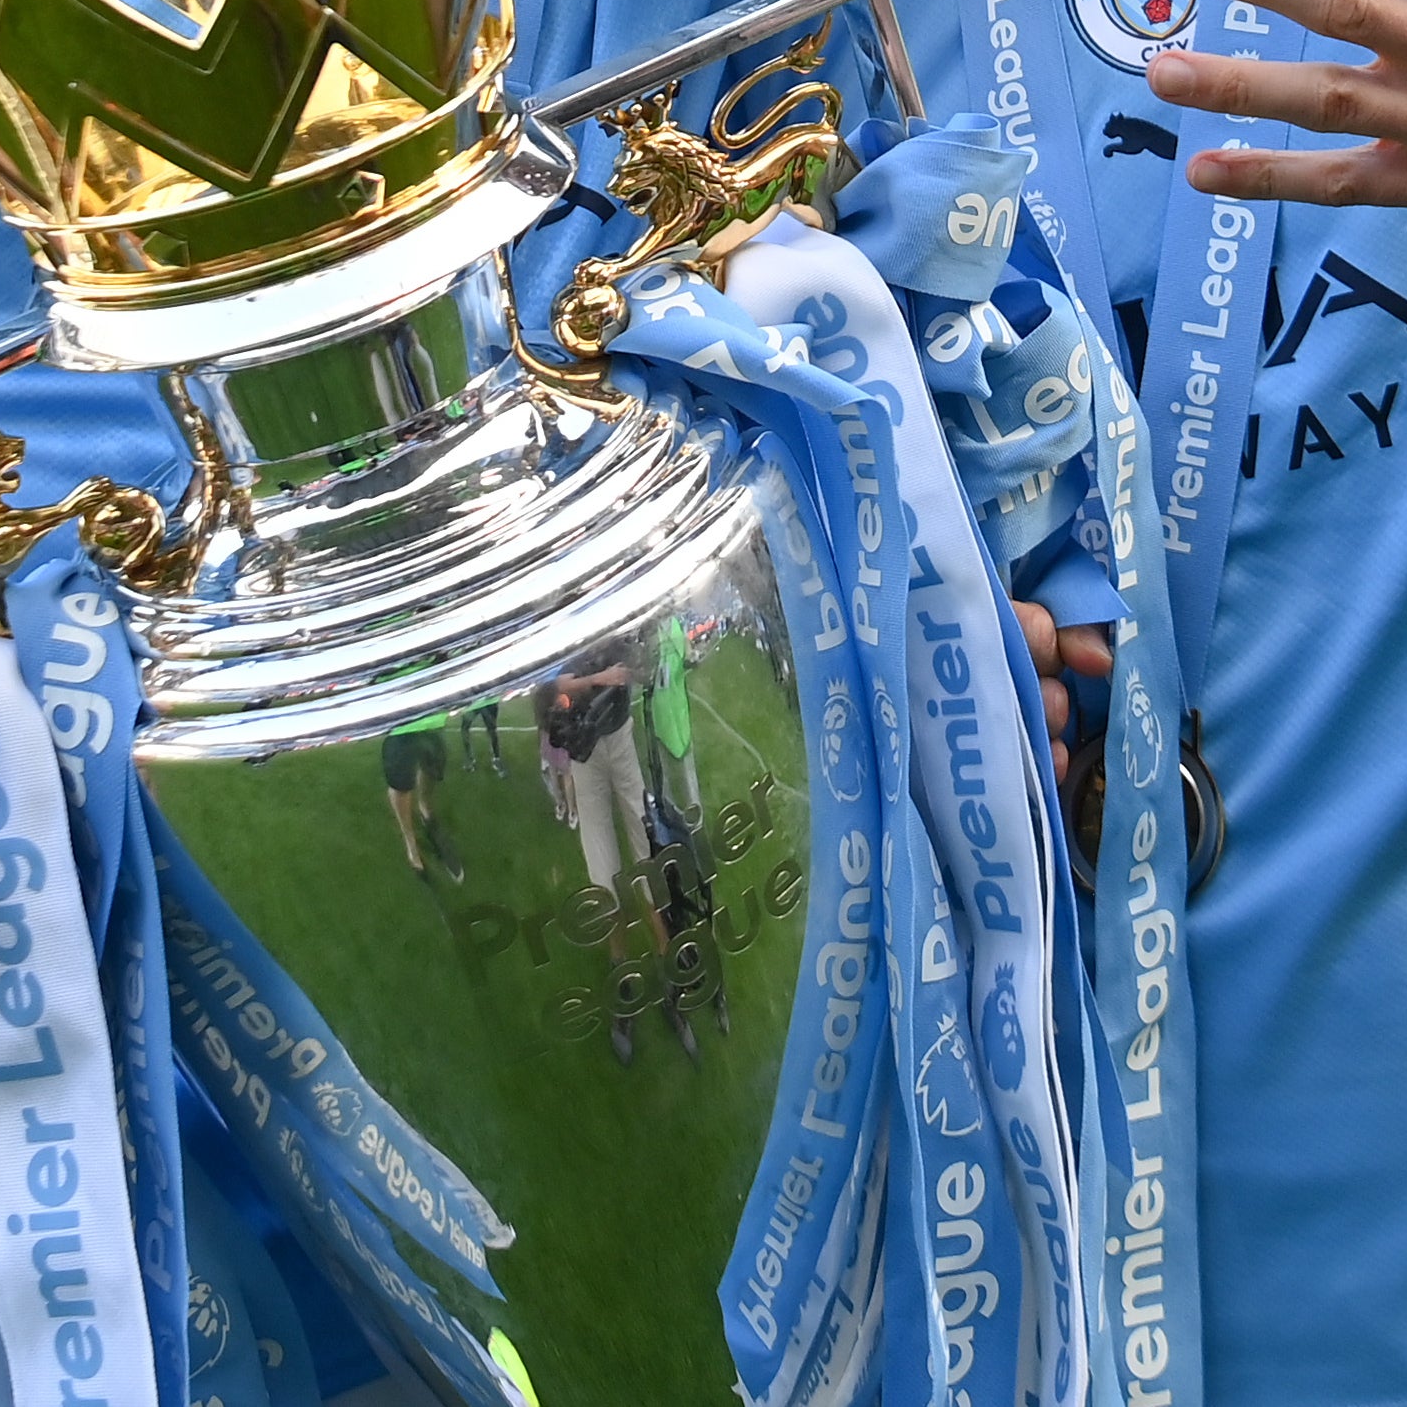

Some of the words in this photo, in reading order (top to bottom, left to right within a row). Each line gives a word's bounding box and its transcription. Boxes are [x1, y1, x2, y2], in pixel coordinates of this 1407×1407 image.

[1181, 138, 1255, 339] Leag
[1160, 350, 1221, 554] Premier
[451, 771, 775, 979] Premier
[916, 610, 1022, 934] Premier
[542, 857, 803, 1042] eague
[1126, 809, 1176, 1121] League
[6, 1105, 109, 1407] remier
[928, 1161, 1000, 1407] ague
[1009, 1116, 1071, 1407] eague
[1105, 1146, 1172, 1407] remier
